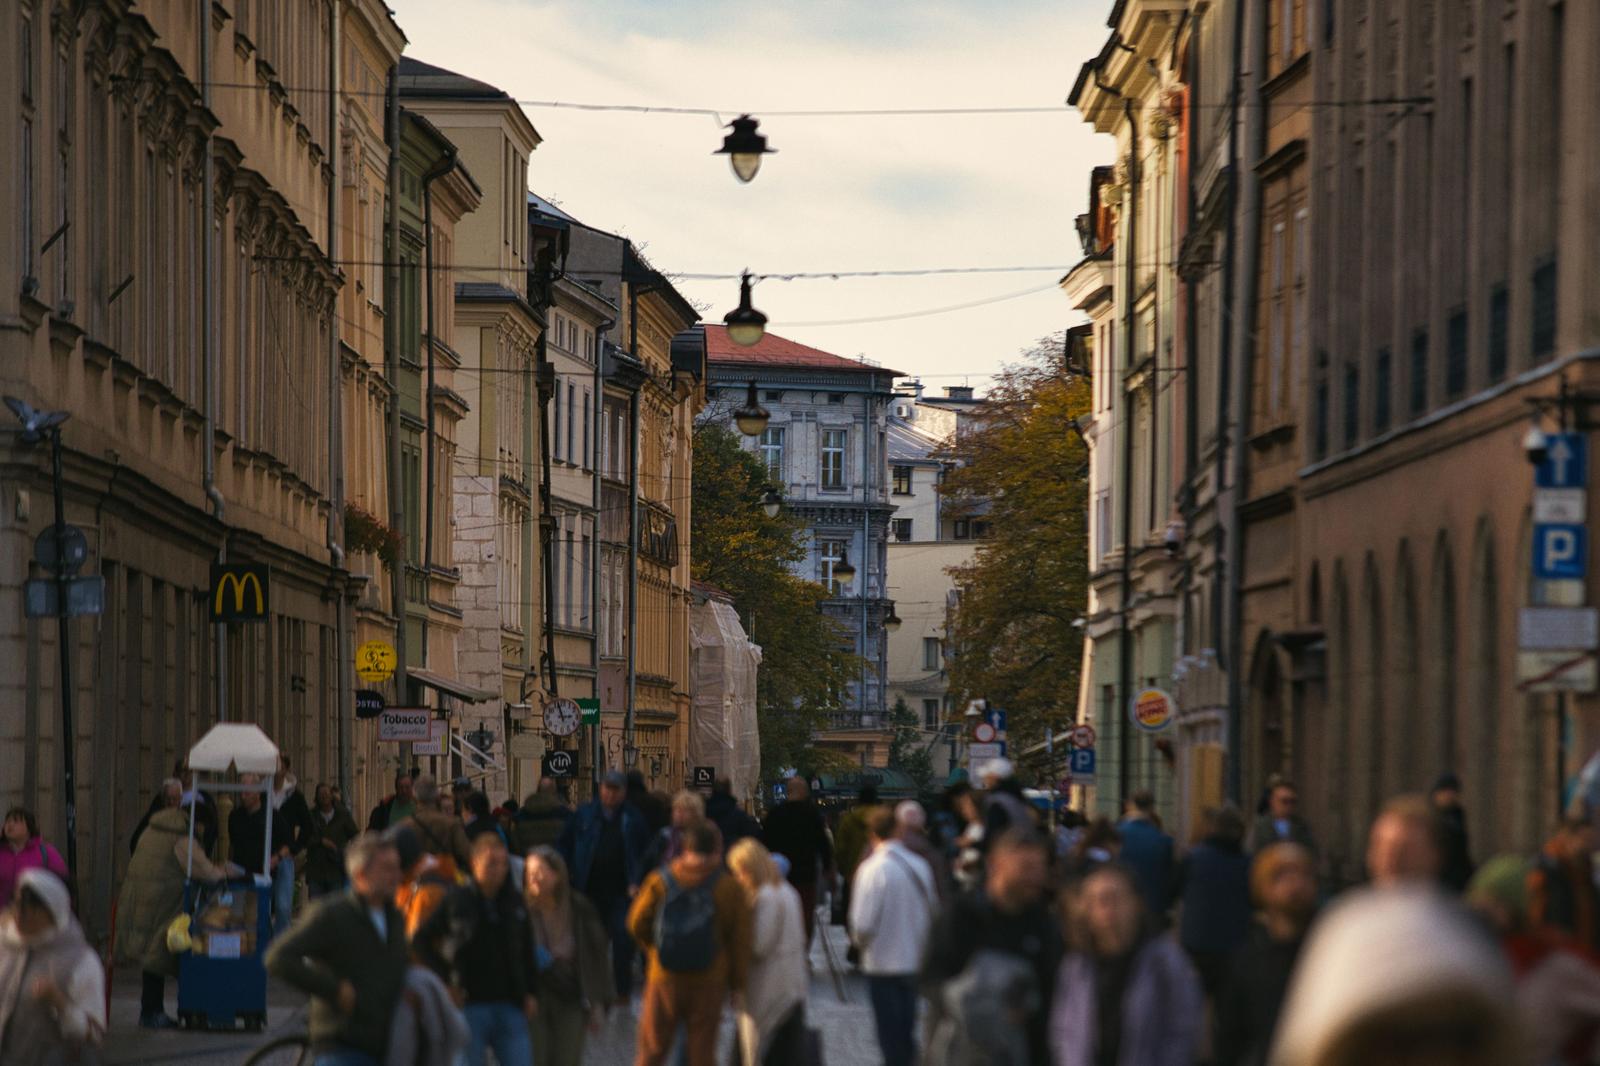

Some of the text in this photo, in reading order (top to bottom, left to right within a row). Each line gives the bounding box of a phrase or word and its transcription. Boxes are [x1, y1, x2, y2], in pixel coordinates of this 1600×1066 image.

[1544, 529, 1576, 570] P
[356, 700, 381, 708] OSTEL
[383, 713, 426, 724] Tobacco
[1076, 751, 1091, 770] P
